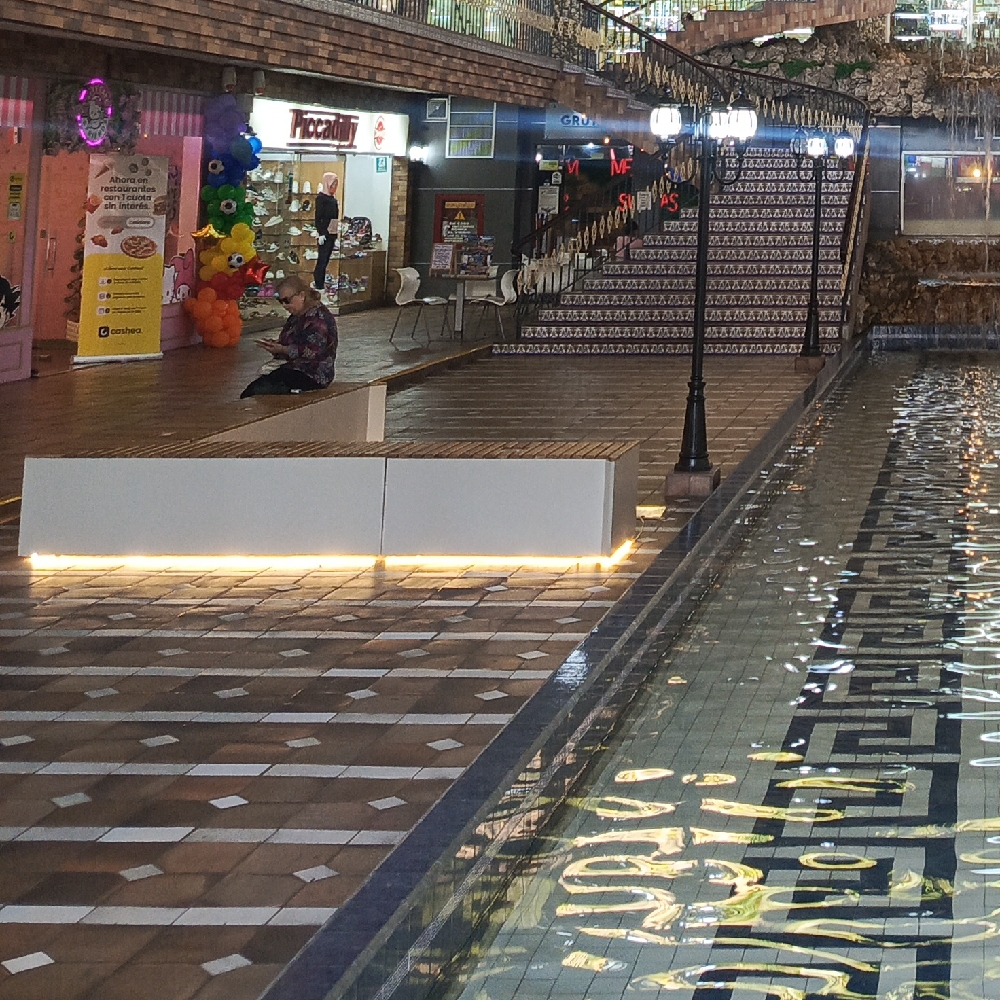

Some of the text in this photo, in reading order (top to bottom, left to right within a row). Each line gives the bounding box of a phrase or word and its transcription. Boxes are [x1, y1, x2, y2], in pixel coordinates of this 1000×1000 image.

[289, 108, 360, 148] Piccadilly
[109, 176, 135, 184] Ahora
[101, 185, 156, 193] restaurantes
[104, 202, 116, 210] sin
